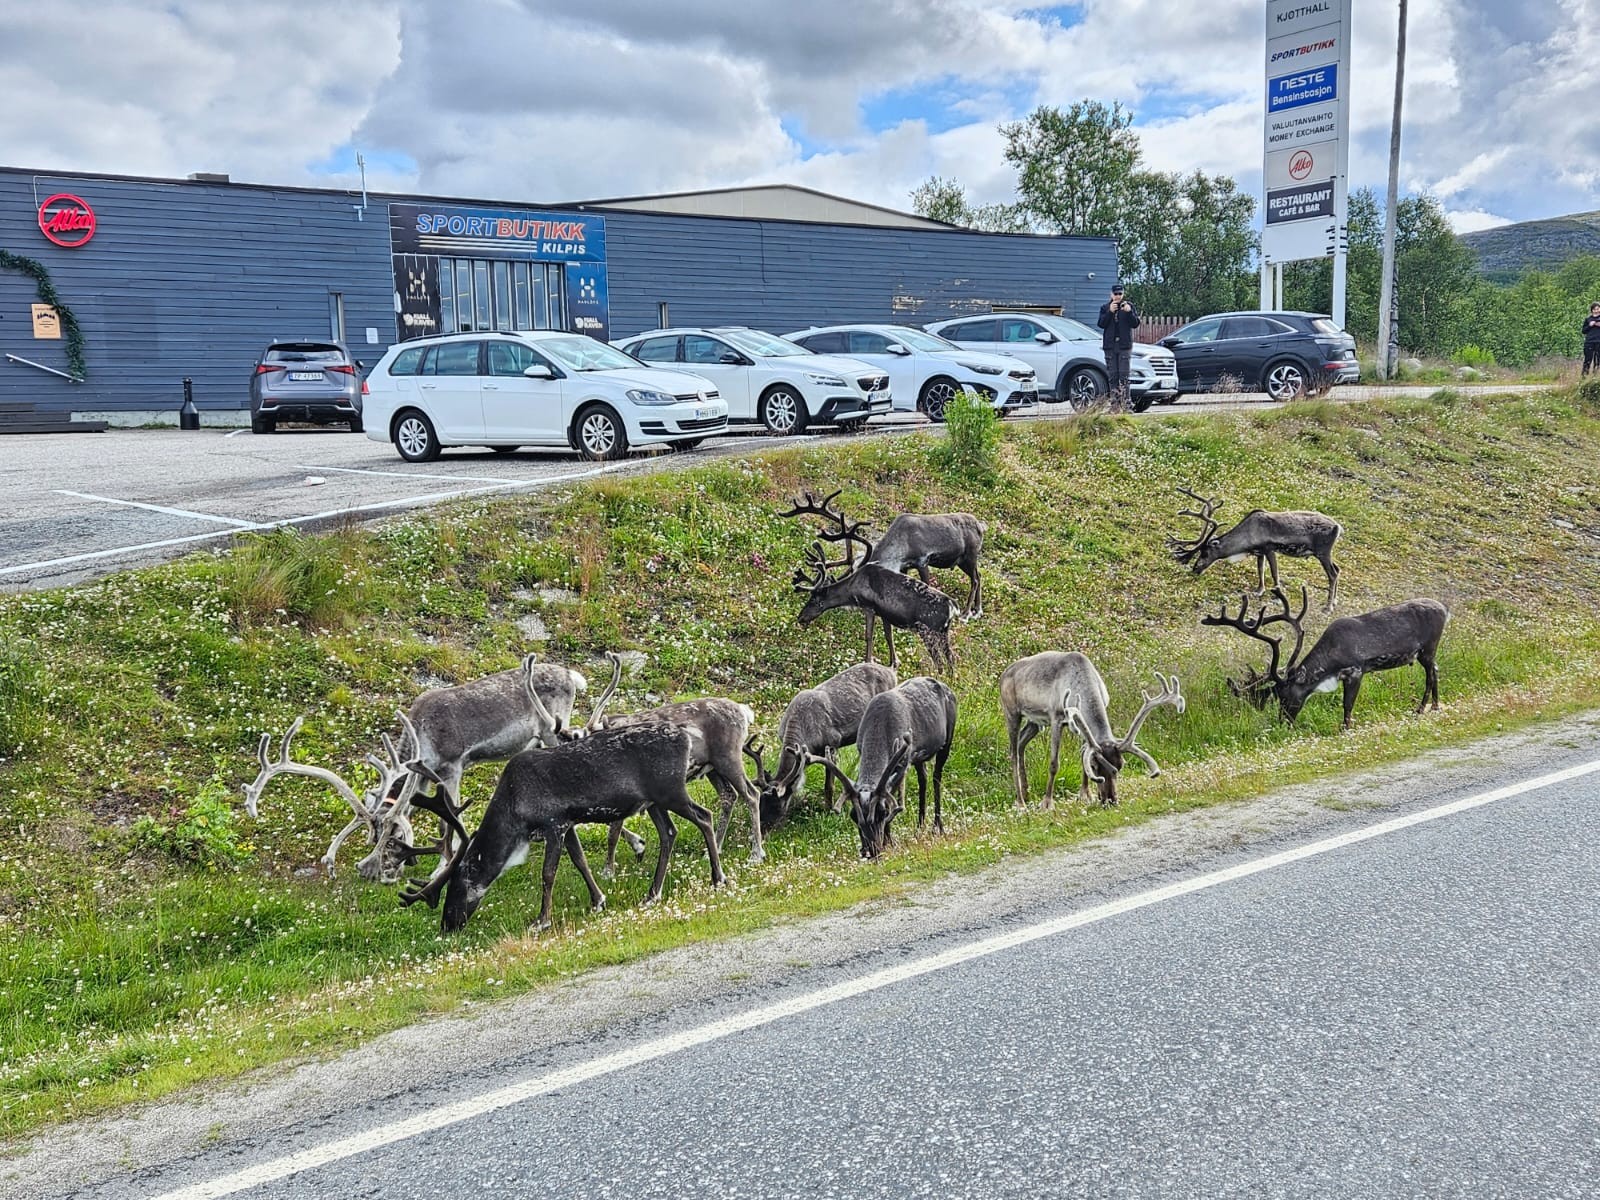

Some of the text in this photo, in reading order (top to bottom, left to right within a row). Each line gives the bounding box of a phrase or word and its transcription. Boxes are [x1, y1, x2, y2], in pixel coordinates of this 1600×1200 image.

[1271, 38, 1336, 62] SPORTBUTIKK
[1272, 85, 1332, 106] Bensinstasjon
[1272, 112, 1333, 130] VALUUTANVAIHTO
[1269, 123, 1335, 142] MONEY EXCHANGE
[1289, 157, 1312, 173] Alko
[1270, 189, 1331, 209] RESTAURANT
[1305, 203, 1320, 213] BAR
[43, 207, 91, 232] Alko
[416, 213, 586, 241] SPORTBUTIKK
[542, 242, 586, 255] KILPIS
